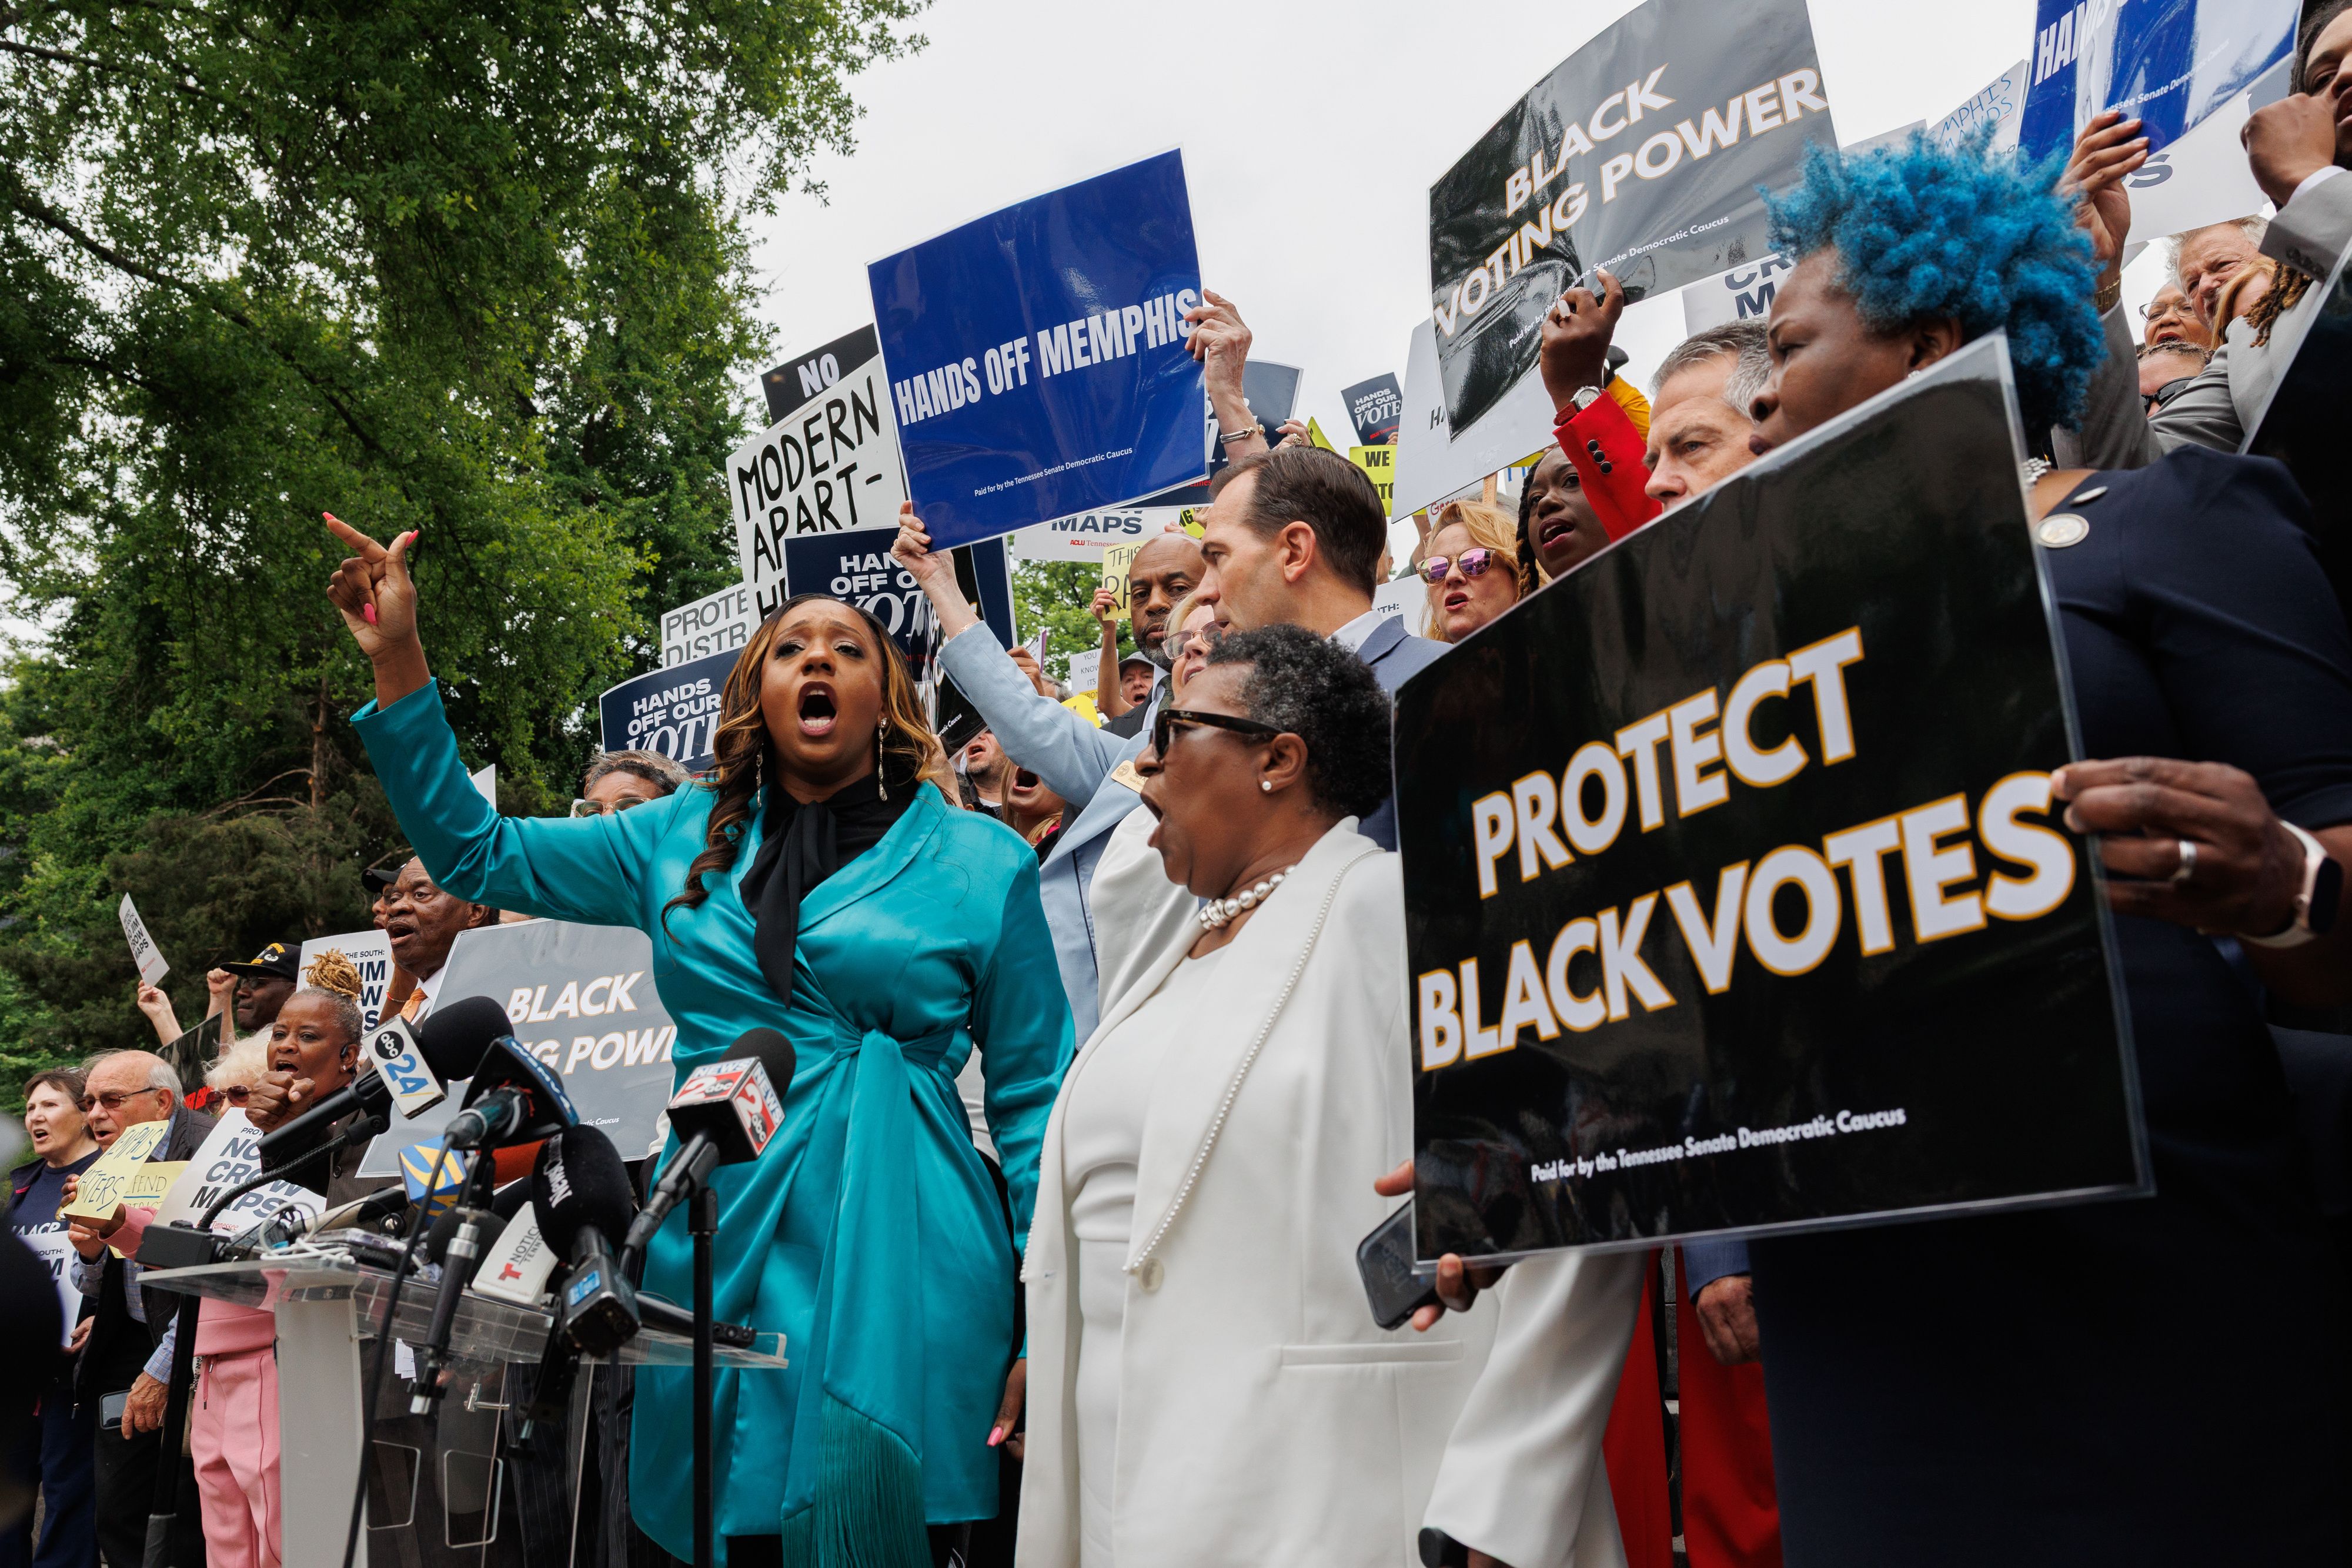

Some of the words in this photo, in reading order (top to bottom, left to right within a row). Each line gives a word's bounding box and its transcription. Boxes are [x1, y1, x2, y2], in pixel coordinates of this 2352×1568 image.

[2137, 85, 2169, 104] Senate
[1506, 63, 1676, 218] BLACK
[1433, 183, 1588, 337] VOTING
[1601, 67, 1829, 203] POWER
[1509, 329, 1524, 348] Paid
[1524, 321, 1534, 334] for
[1535, 312, 1545, 324] by
[1593, 253, 1628, 272] Senate
[1628, 230, 1689, 258] Democratic
[1689, 215, 1729, 235] Caucus
[797, 353, 840, 398] NO
[894, 357, 981, 426] HANDS
[984, 336, 1030, 396] OFF
[1037, 287, 1197, 378] MEMPHIS
[1354, 401, 1374, 414] OFF
[1375, 394, 1398, 405] OUR
[1355, 388, 1391, 406] HANDS
[1355, 400, 1401, 431] VOTE
[737, 375, 881, 523] MODERN
[1365, 450, 1390, 467] WE
[974, 487, 987, 497] Paid
[996, 483, 1004, 492] by
[1004, 480, 1014, 488] the
[1014, 471, 1044, 485] Tennessee
[1044, 465, 1065, 476] Senate
[1065, 454, 1105, 469] Democratic
[1106, 447, 1132, 459] Caucus
[754, 462, 882, 583] APART-
[1051, 515, 1142, 534] MAPS
[840, 553, 904, 573] HAN
[830, 573, 888, 594] OFF
[666, 589, 748, 642] PROTE
[666, 622, 747, 667] DISTR
[1083, 651, 1097, 660] YOU
[633, 678, 711, 717] HANDS
[1087, 678, 1097, 686] ITS
[627, 709, 667, 736] OFF
[673, 693, 721, 720] OUR
[948, 713, 963, 728] Caucus
[1471, 625, 1865, 900] PROTECT
[1418, 891, 1678, 1072] BLACK
[1663, 770, 2078, 996] VOTES
[360, 949, 385, 958] SOUTH:
[506, 971, 645, 1025] BLACK
[380, 1033, 399, 1058] abc
[384, 1054, 429, 1095] 24
[694, 1058, 753, 1078] NEWS
[676, 1076, 717, 1101] 2
[704, 1081, 734, 1094] abc
[754, 1066, 781, 1126] NEWS
[595, 1117, 620, 1125] Caucus
[736, 1083, 763, 1129] 2
[751, 1114, 766, 1143] abc
[1531, 1162, 1558, 1183] Paid
[1558, 1156, 1577, 1178] for
[1577, 1156, 1595, 1179] by
[1595, 1151, 1618, 1173] the
[1617, 1144, 1684, 1169] Tennessee
[1685, 1134, 1737, 1157] Senate
[1738, 1115, 1836, 1148] Democratic
[1836, 1108, 1907, 1134] Caucus
[125, 1175, 167, 1194] FEND
[189, 1186, 288, 1219] MPS
